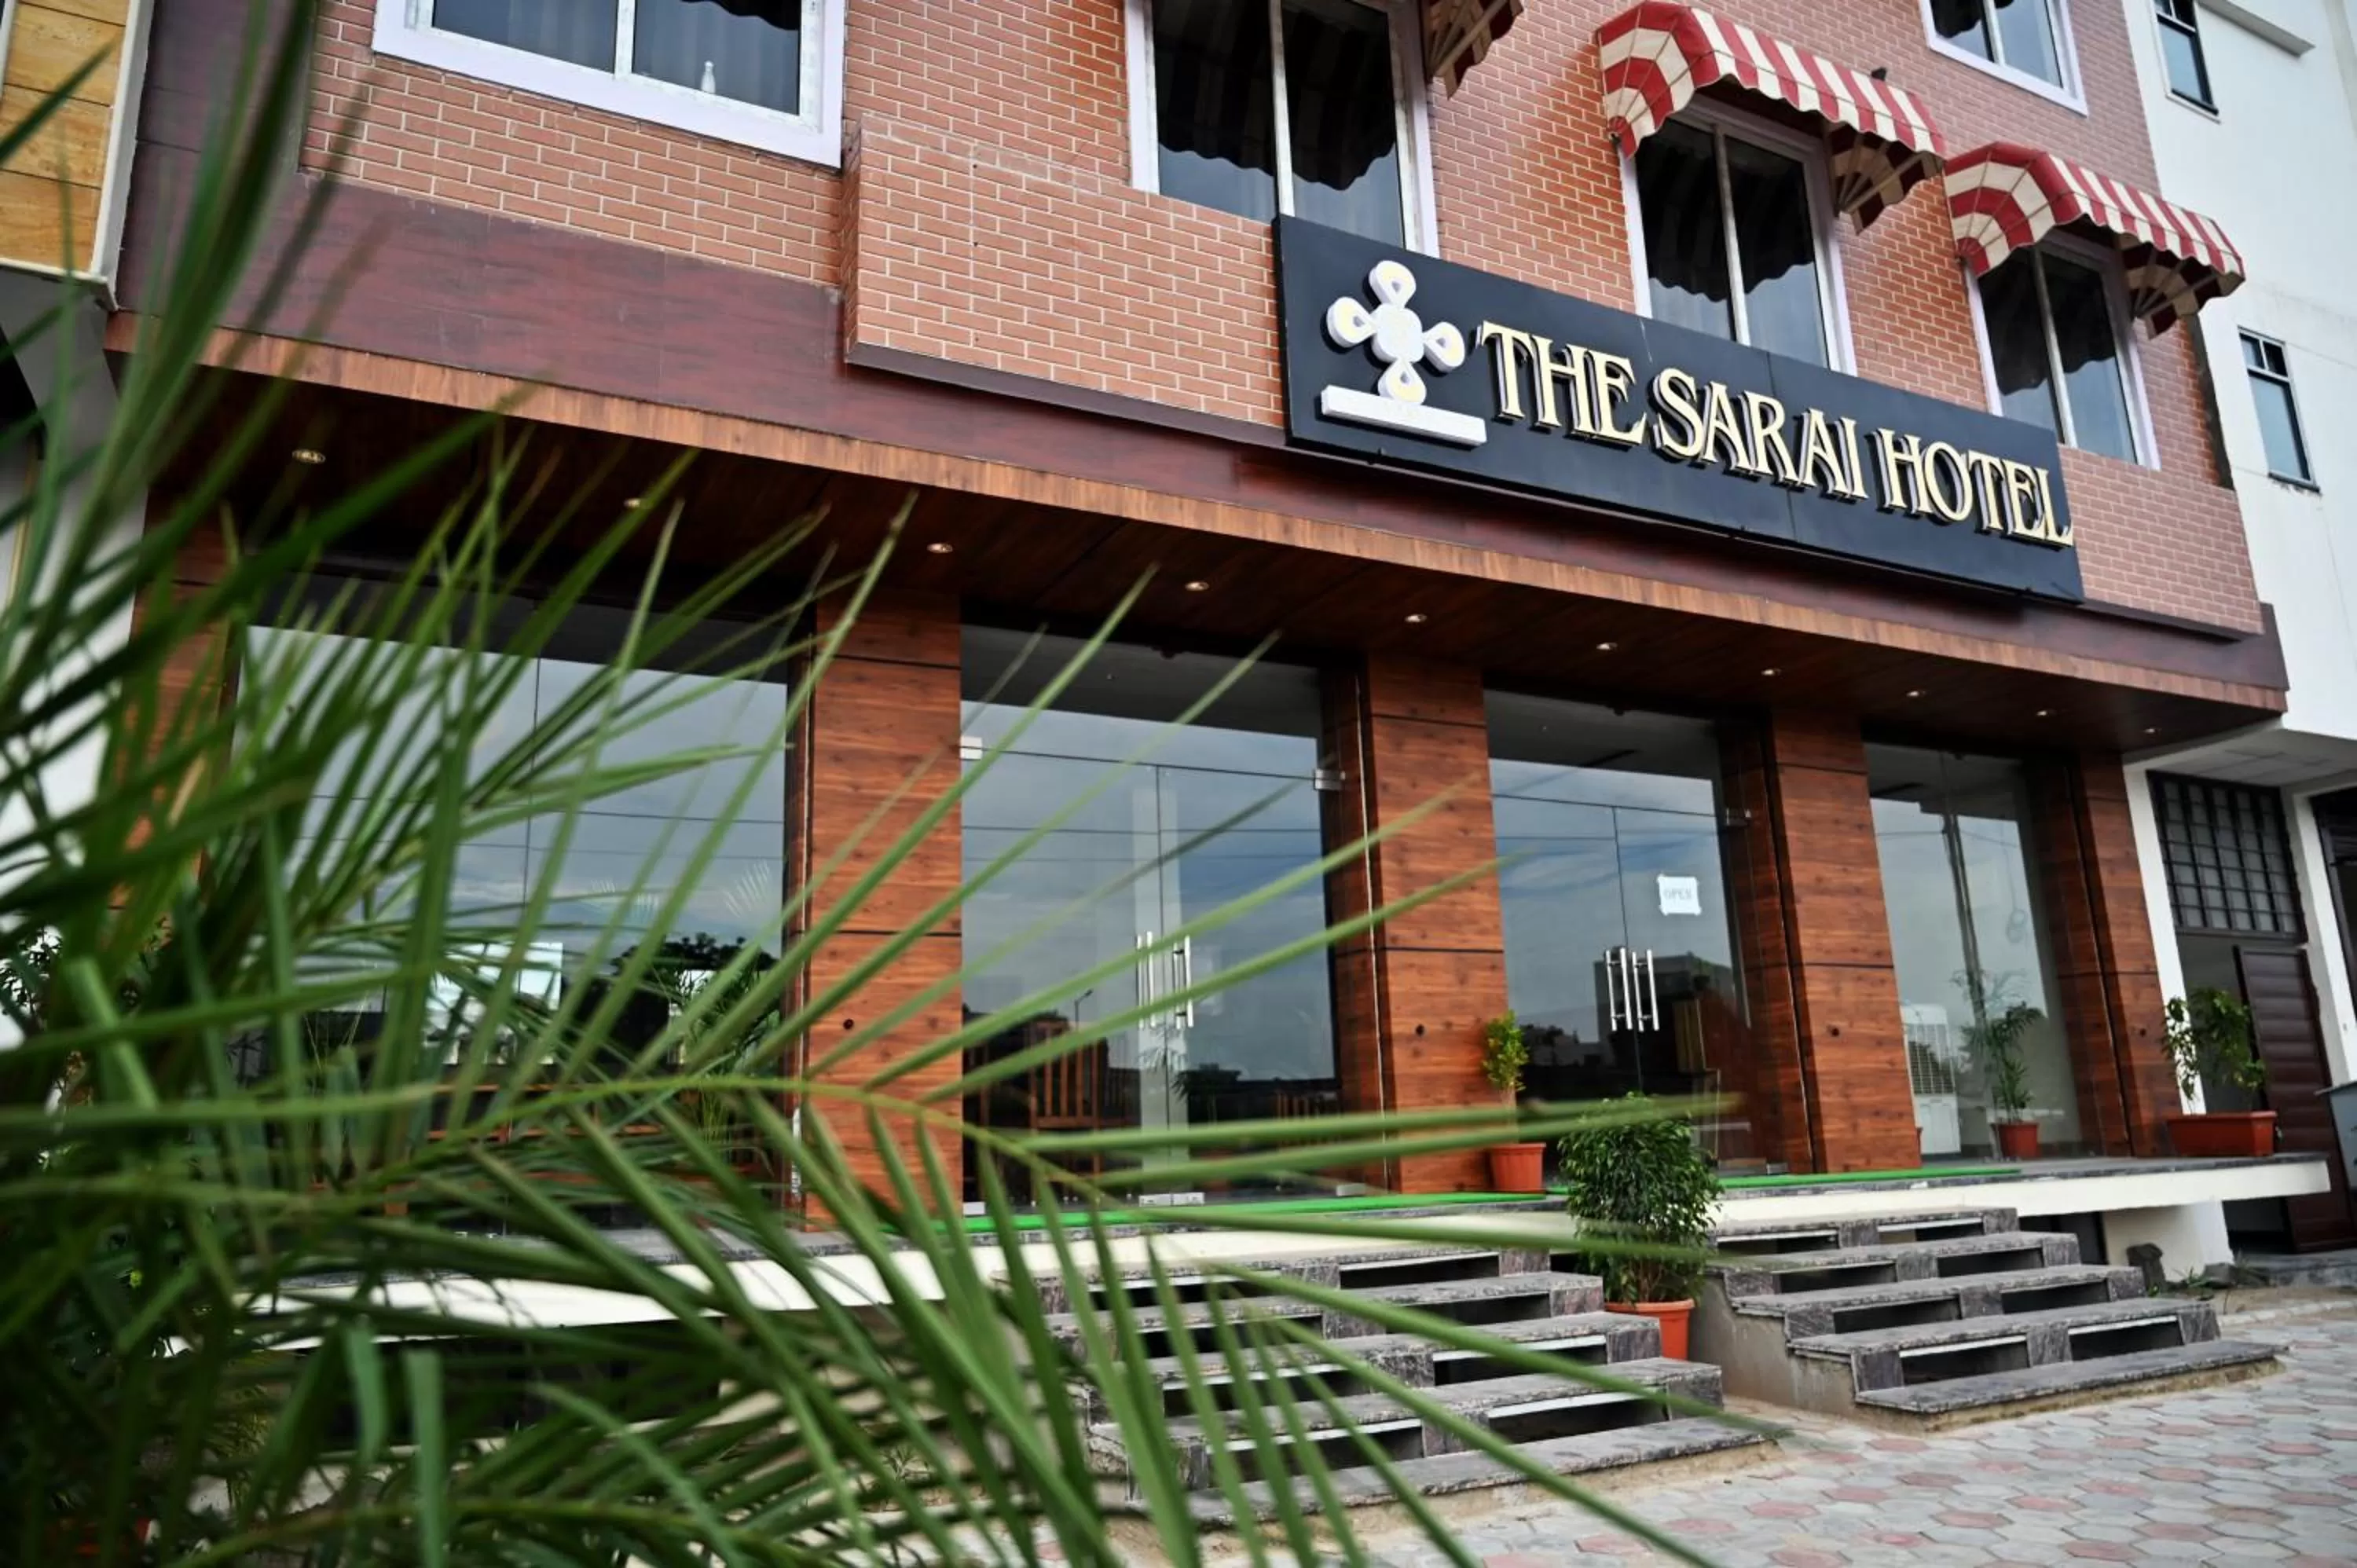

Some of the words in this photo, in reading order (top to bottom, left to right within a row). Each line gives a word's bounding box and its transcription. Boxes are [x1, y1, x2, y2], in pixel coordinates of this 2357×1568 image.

[1476, 320, 1648, 447] THE
[1651, 367, 1869, 500] SARAI
[1873, 427, 2074, 547] HOTEL
